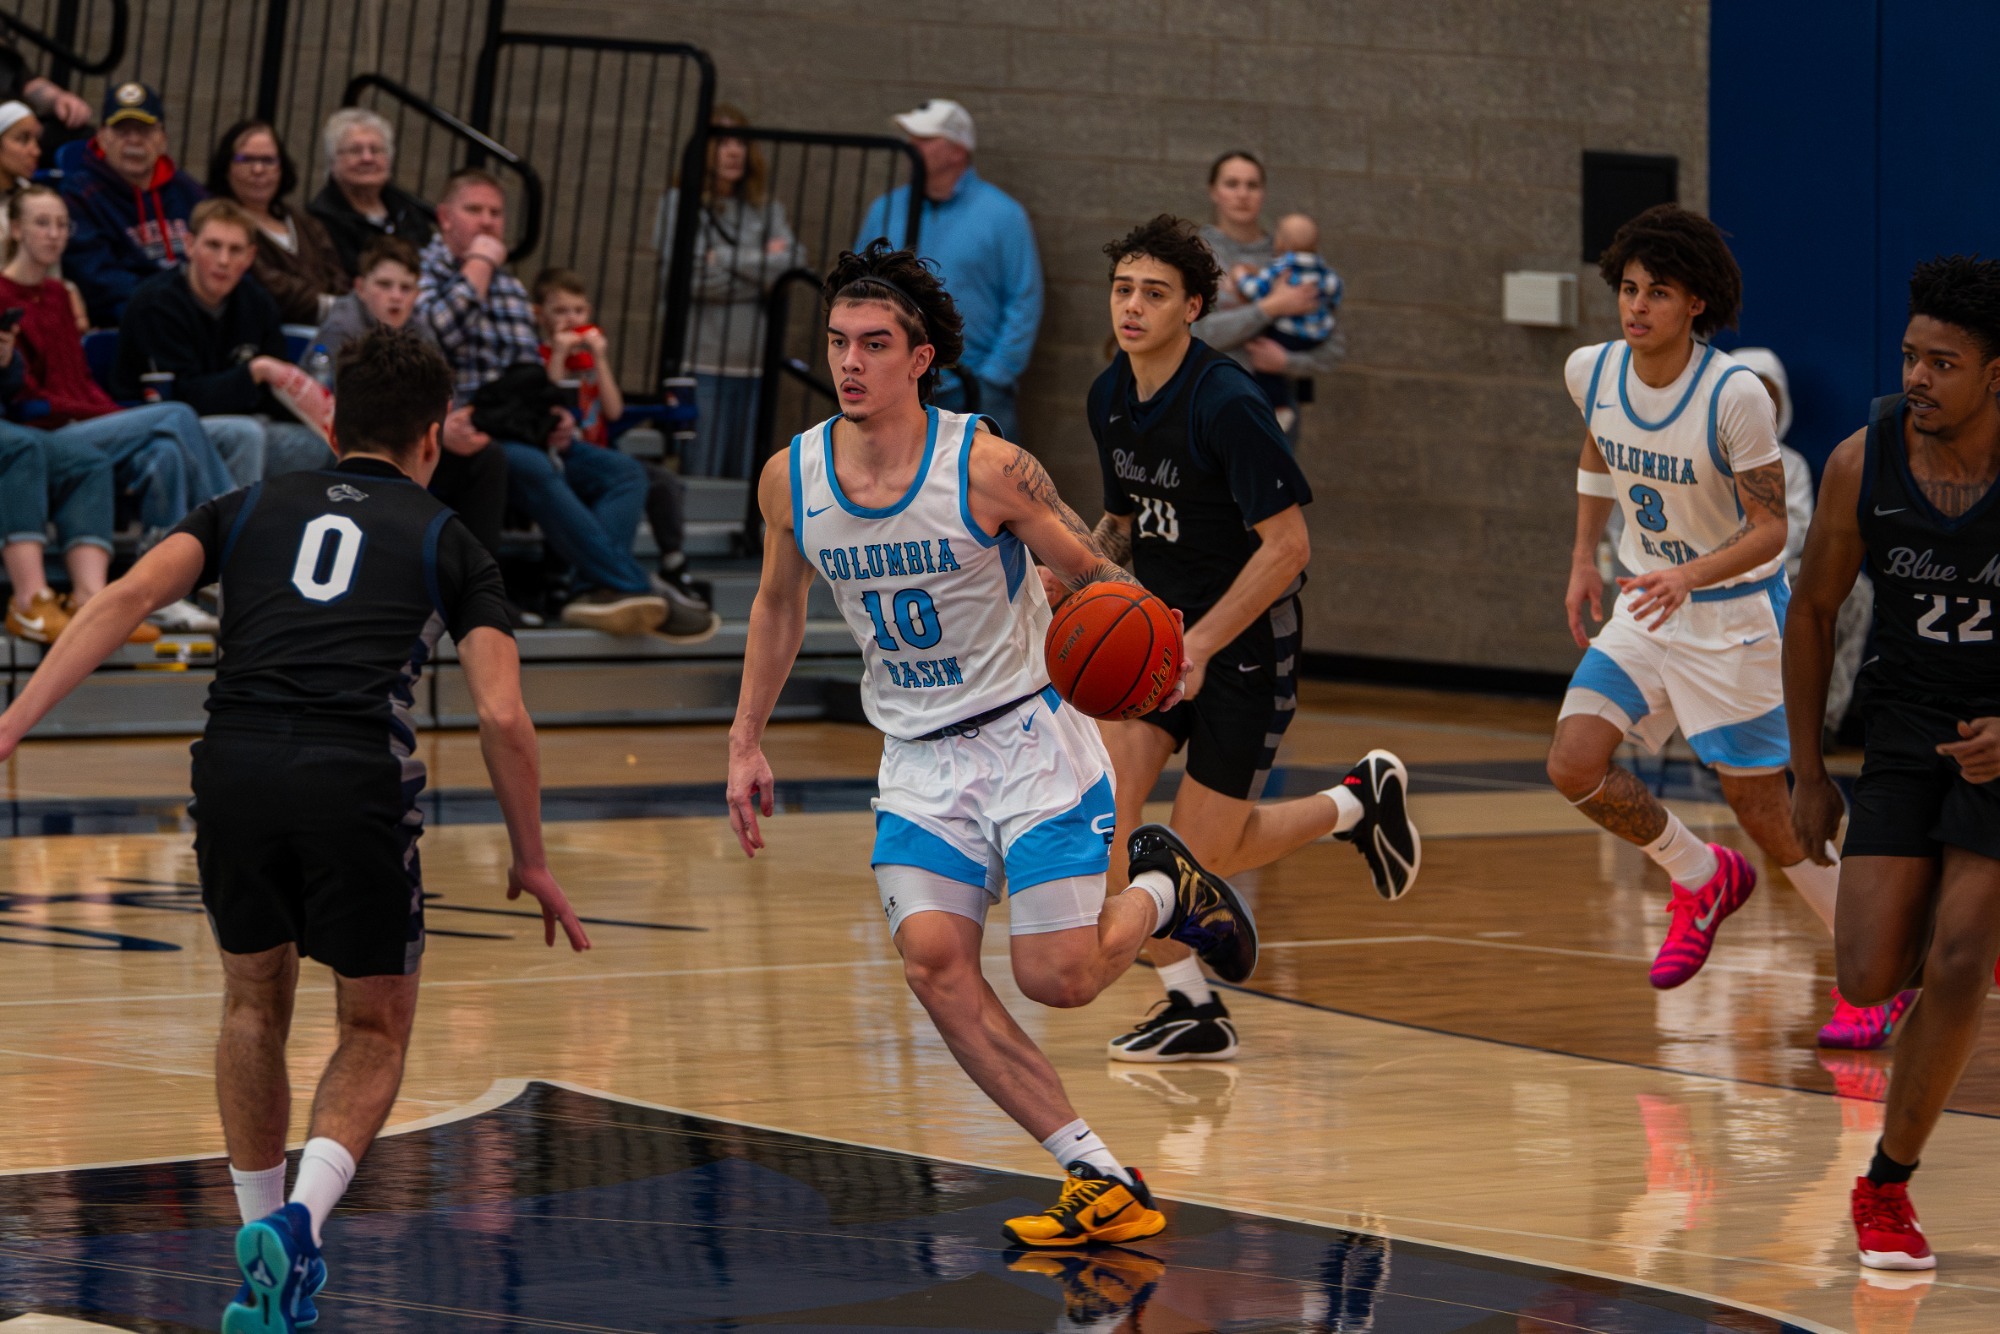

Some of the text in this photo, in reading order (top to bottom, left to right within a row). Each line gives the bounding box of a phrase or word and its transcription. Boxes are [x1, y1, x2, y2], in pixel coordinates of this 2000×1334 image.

[1112, 448, 1181, 489] Blue Mt
[1629, 483, 1668, 533] 3
[291, 512, 365, 604] 0
[819, 537, 961, 581] COLUMBIA
[1883, 546, 1958, 582] Blue
[861, 587, 943, 651] 10
[1913, 593, 1994, 643] 22
[882, 657, 963, 688] BASIN
[1120, 645, 1174, 721] Baden
